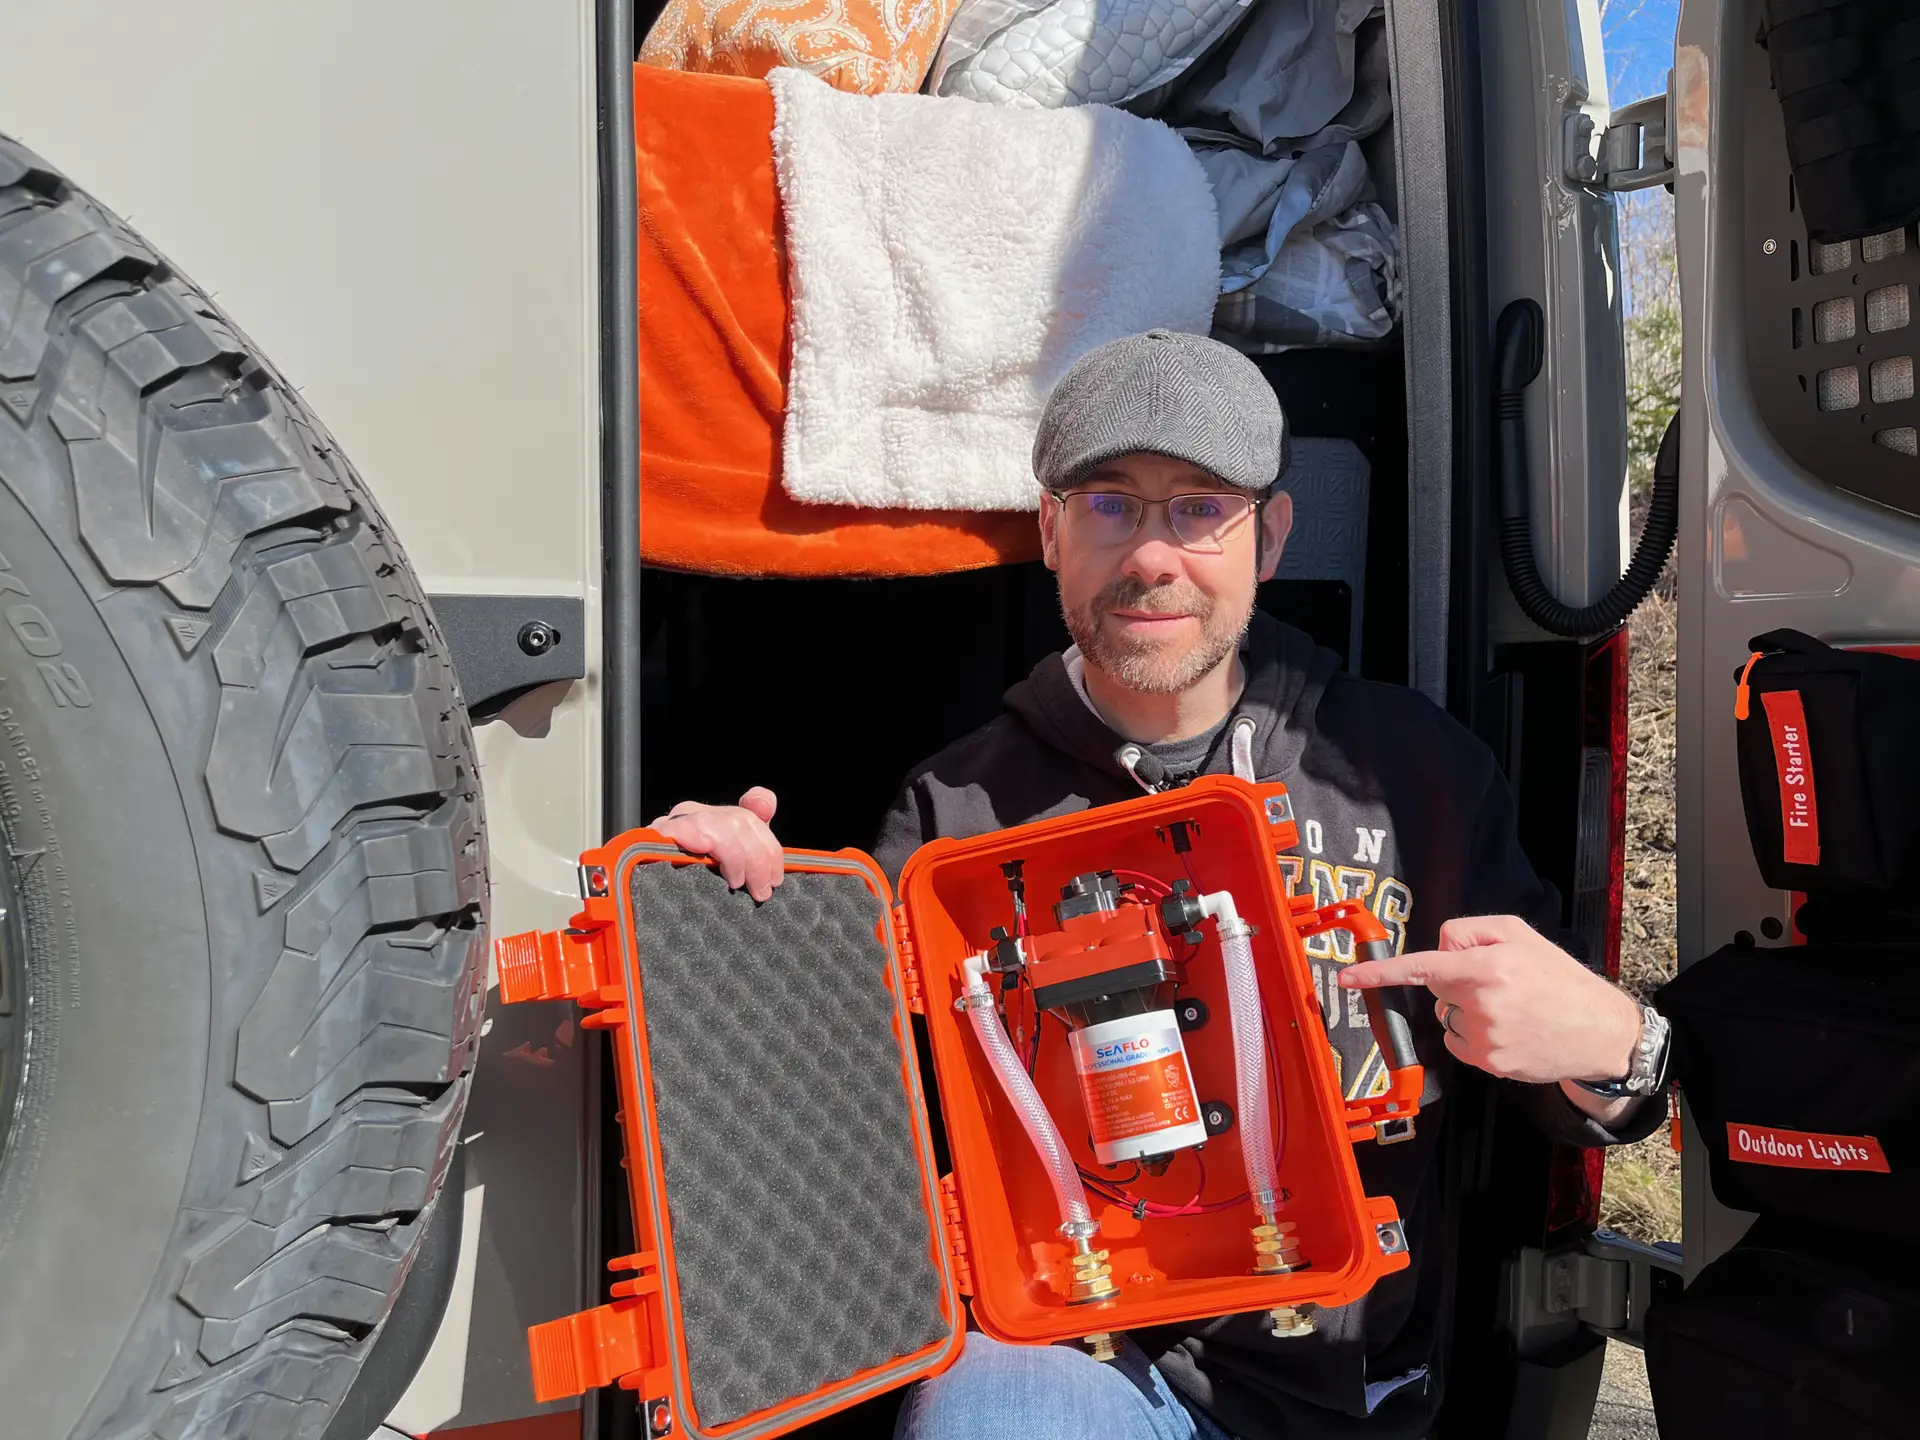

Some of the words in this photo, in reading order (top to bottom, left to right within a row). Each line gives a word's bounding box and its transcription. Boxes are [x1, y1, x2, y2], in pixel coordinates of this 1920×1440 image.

[1783, 725, 1805, 786] Starter
[1789, 792, 1809, 827] Fire
[1084, 1057, 1125, 1070] ROFESSIONAL
[1096, 1038, 1149, 1059] SEAFLO
[1738, 1129, 1804, 1159] Outdoor
[1808, 1139, 1869, 1166] Lights
